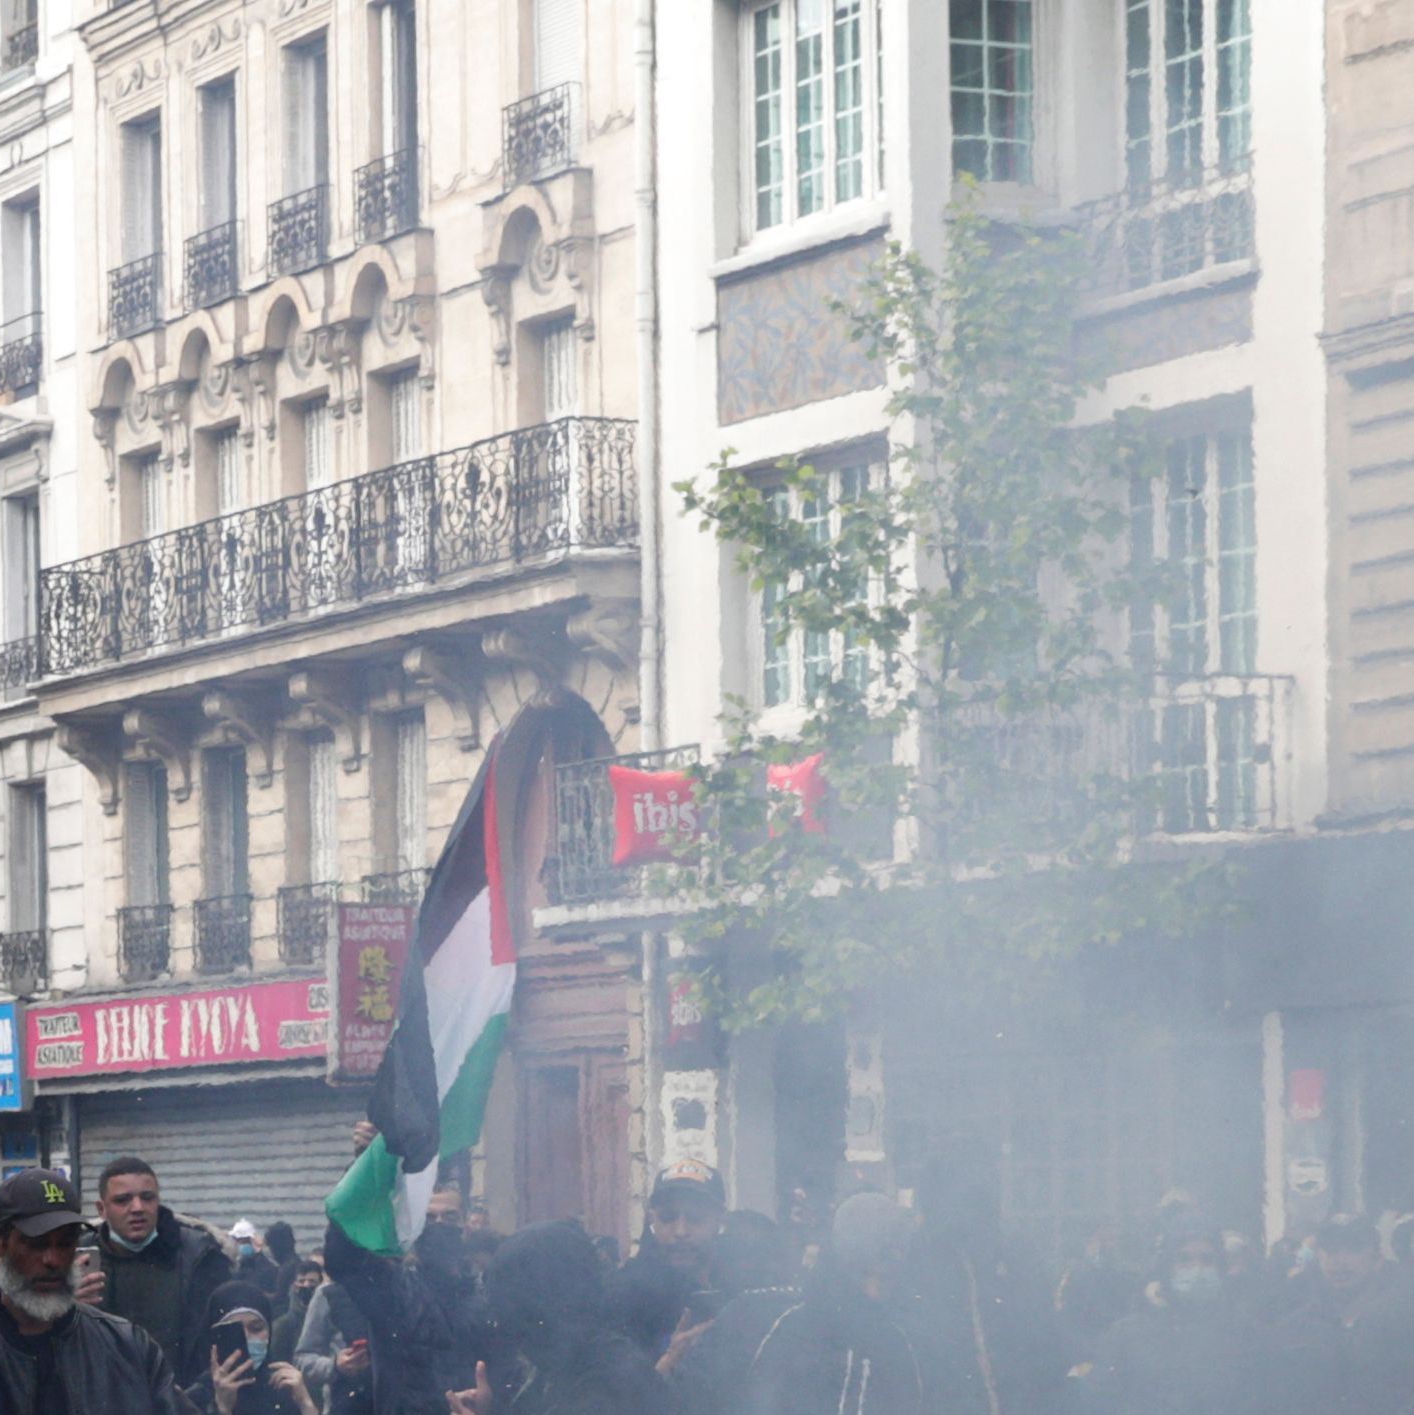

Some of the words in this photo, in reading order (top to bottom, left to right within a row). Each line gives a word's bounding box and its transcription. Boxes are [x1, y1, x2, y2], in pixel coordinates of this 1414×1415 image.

[633, 790, 697, 834] ibis
[38, 1014, 79, 1036] TRAITEUR
[37, 1043, 83, 1067] ASIATIQUE
[40, 1179, 66, 1203] LA
